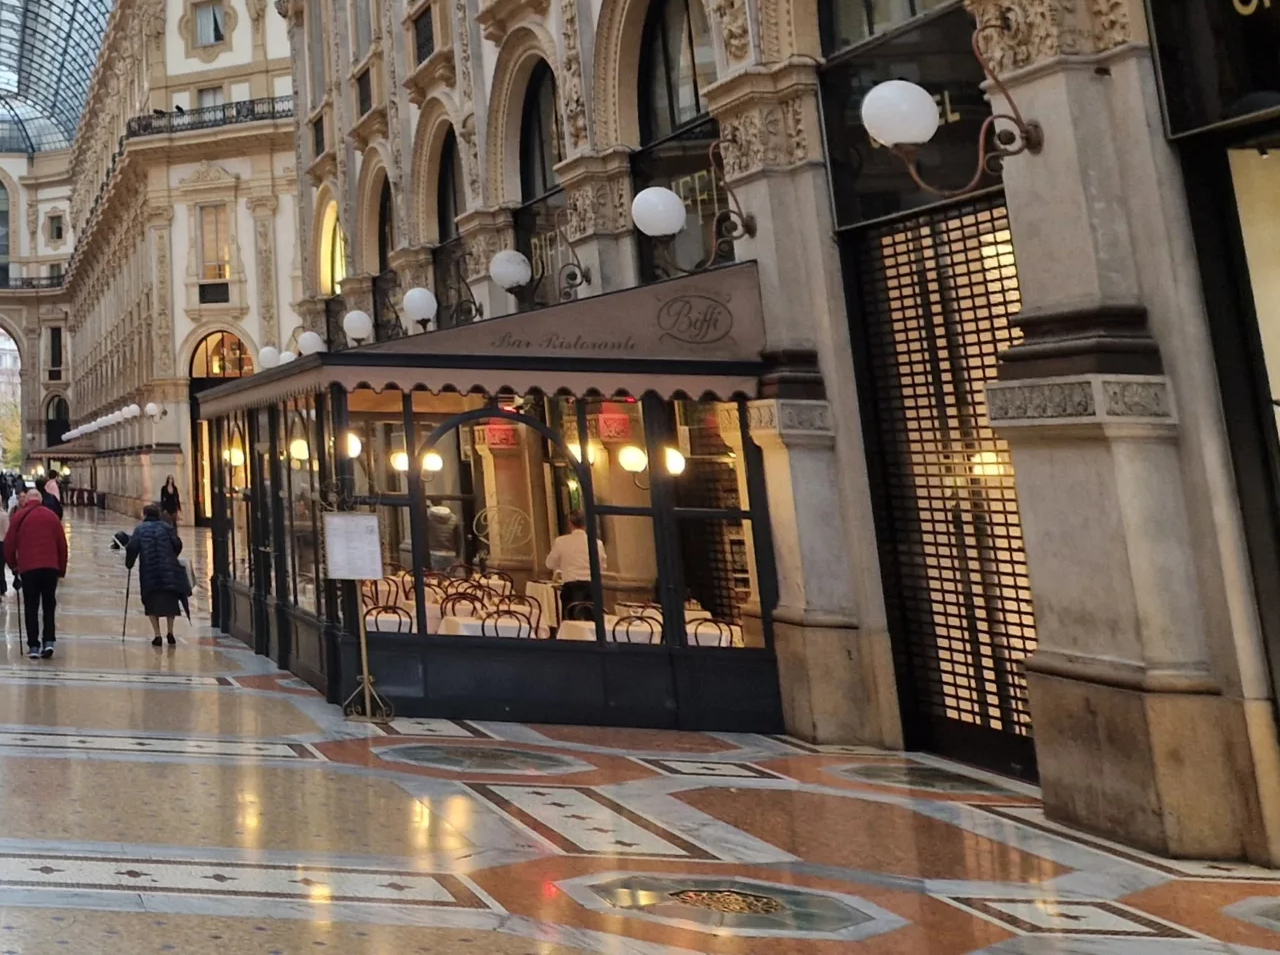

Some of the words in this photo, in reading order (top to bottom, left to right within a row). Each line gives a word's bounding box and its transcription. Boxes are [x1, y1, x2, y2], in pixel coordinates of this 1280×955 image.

[658, 296, 724, 342] Biffi
[490, 331, 532, 349] Bar
[537, 332, 638, 351] Ristorante
